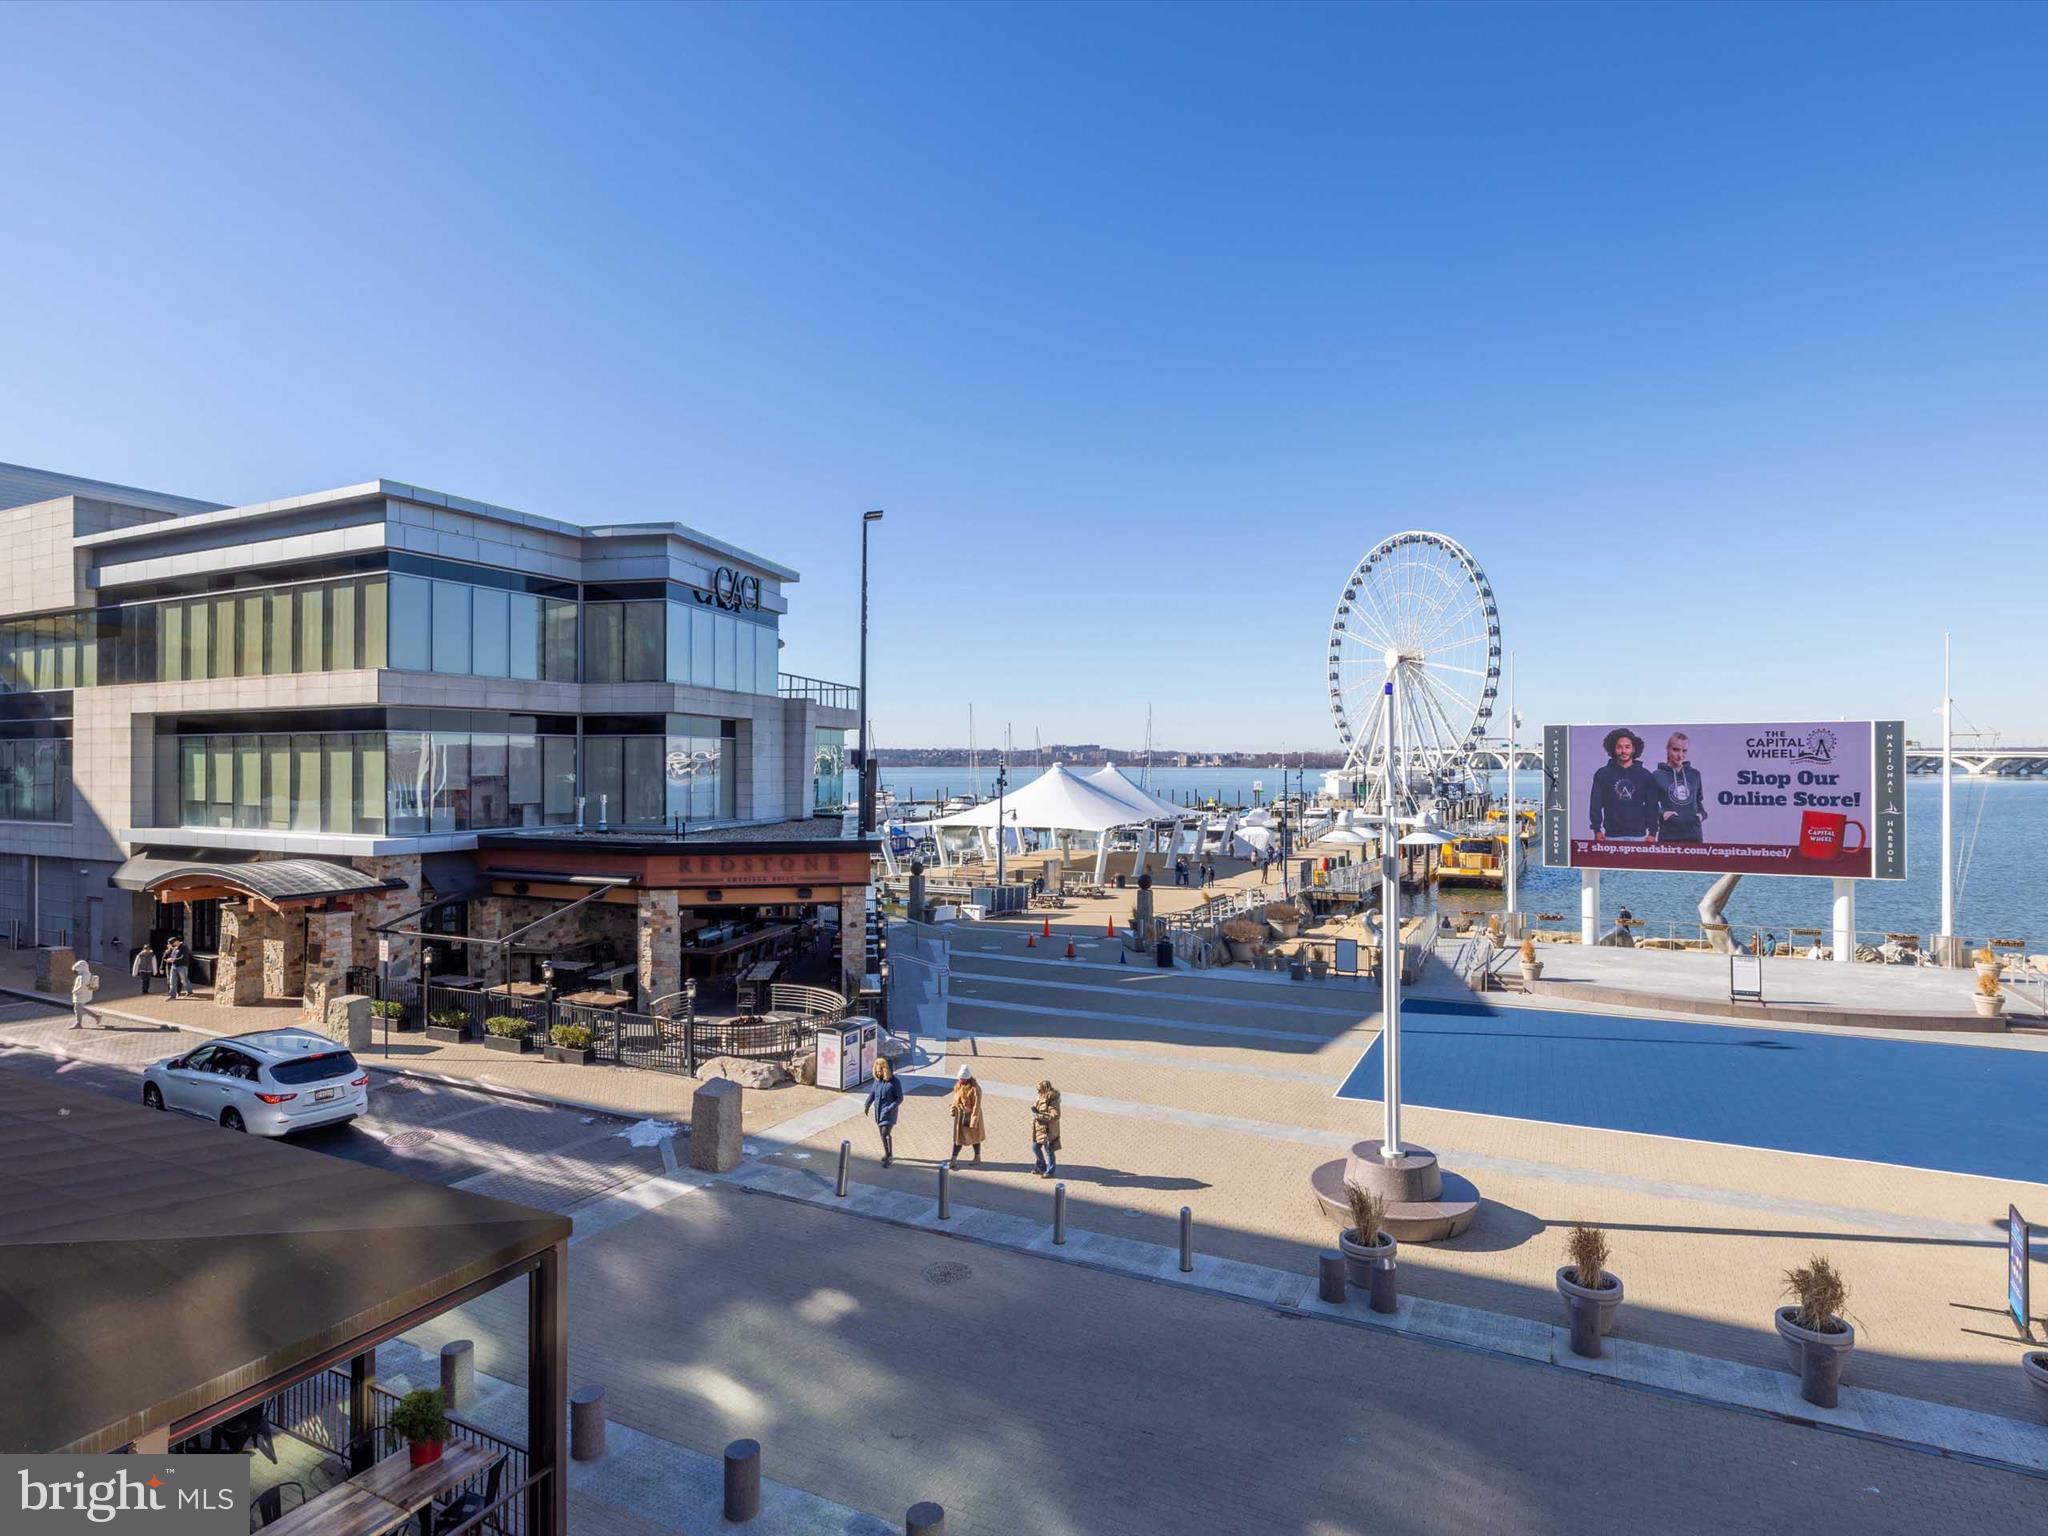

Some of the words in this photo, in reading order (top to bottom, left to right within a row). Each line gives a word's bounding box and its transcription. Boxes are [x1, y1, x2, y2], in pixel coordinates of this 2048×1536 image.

[715, 567, 760, 611] CACI
[1746, 738, 1805, 748] CAPITAL
[1747, 749, 1796, 758] WHEEL
[1886, 734, 1894, 793] NATIONAL
[1737, 770, 1791, 789] Shop
[1797, 770, 1839, 785] Our
[1718, 791, 1787, 806] Online
[1793, 791, 1861, 807] Store!
[1807, 828, 1836, 837] CAPITAL
[1809, 835, 1833, 843] WHEEL
[1592, 844, 1791, 858] shop.spreadshirt.com/capitalwheel/
[679, 856, 839, 873] REDSTONE
